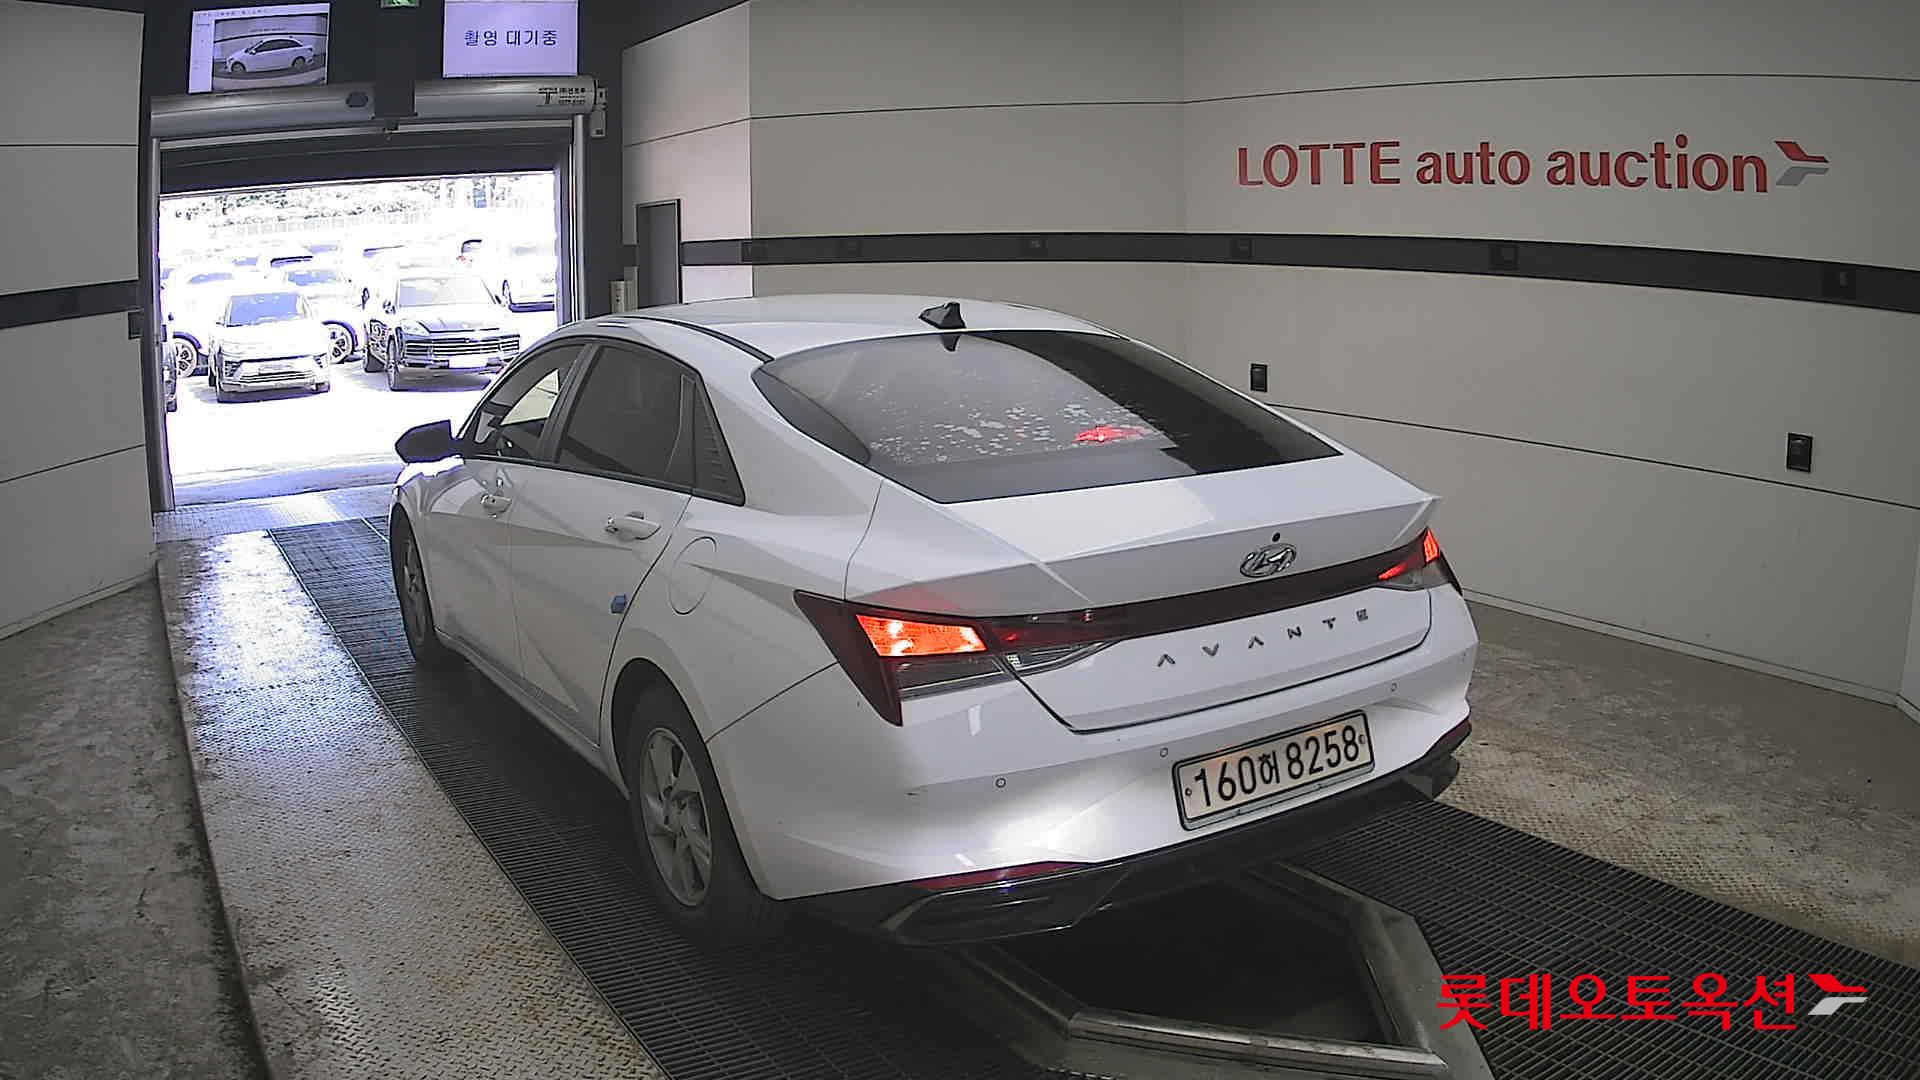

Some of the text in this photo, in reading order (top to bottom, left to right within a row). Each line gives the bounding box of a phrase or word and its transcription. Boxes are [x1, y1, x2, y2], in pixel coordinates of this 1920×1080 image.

[506, 29, 558, 47] 대기중
[1237, 134, 1768, 193] LOTTE auto auction
[1157, 607, 1369, 668] AVANTE
